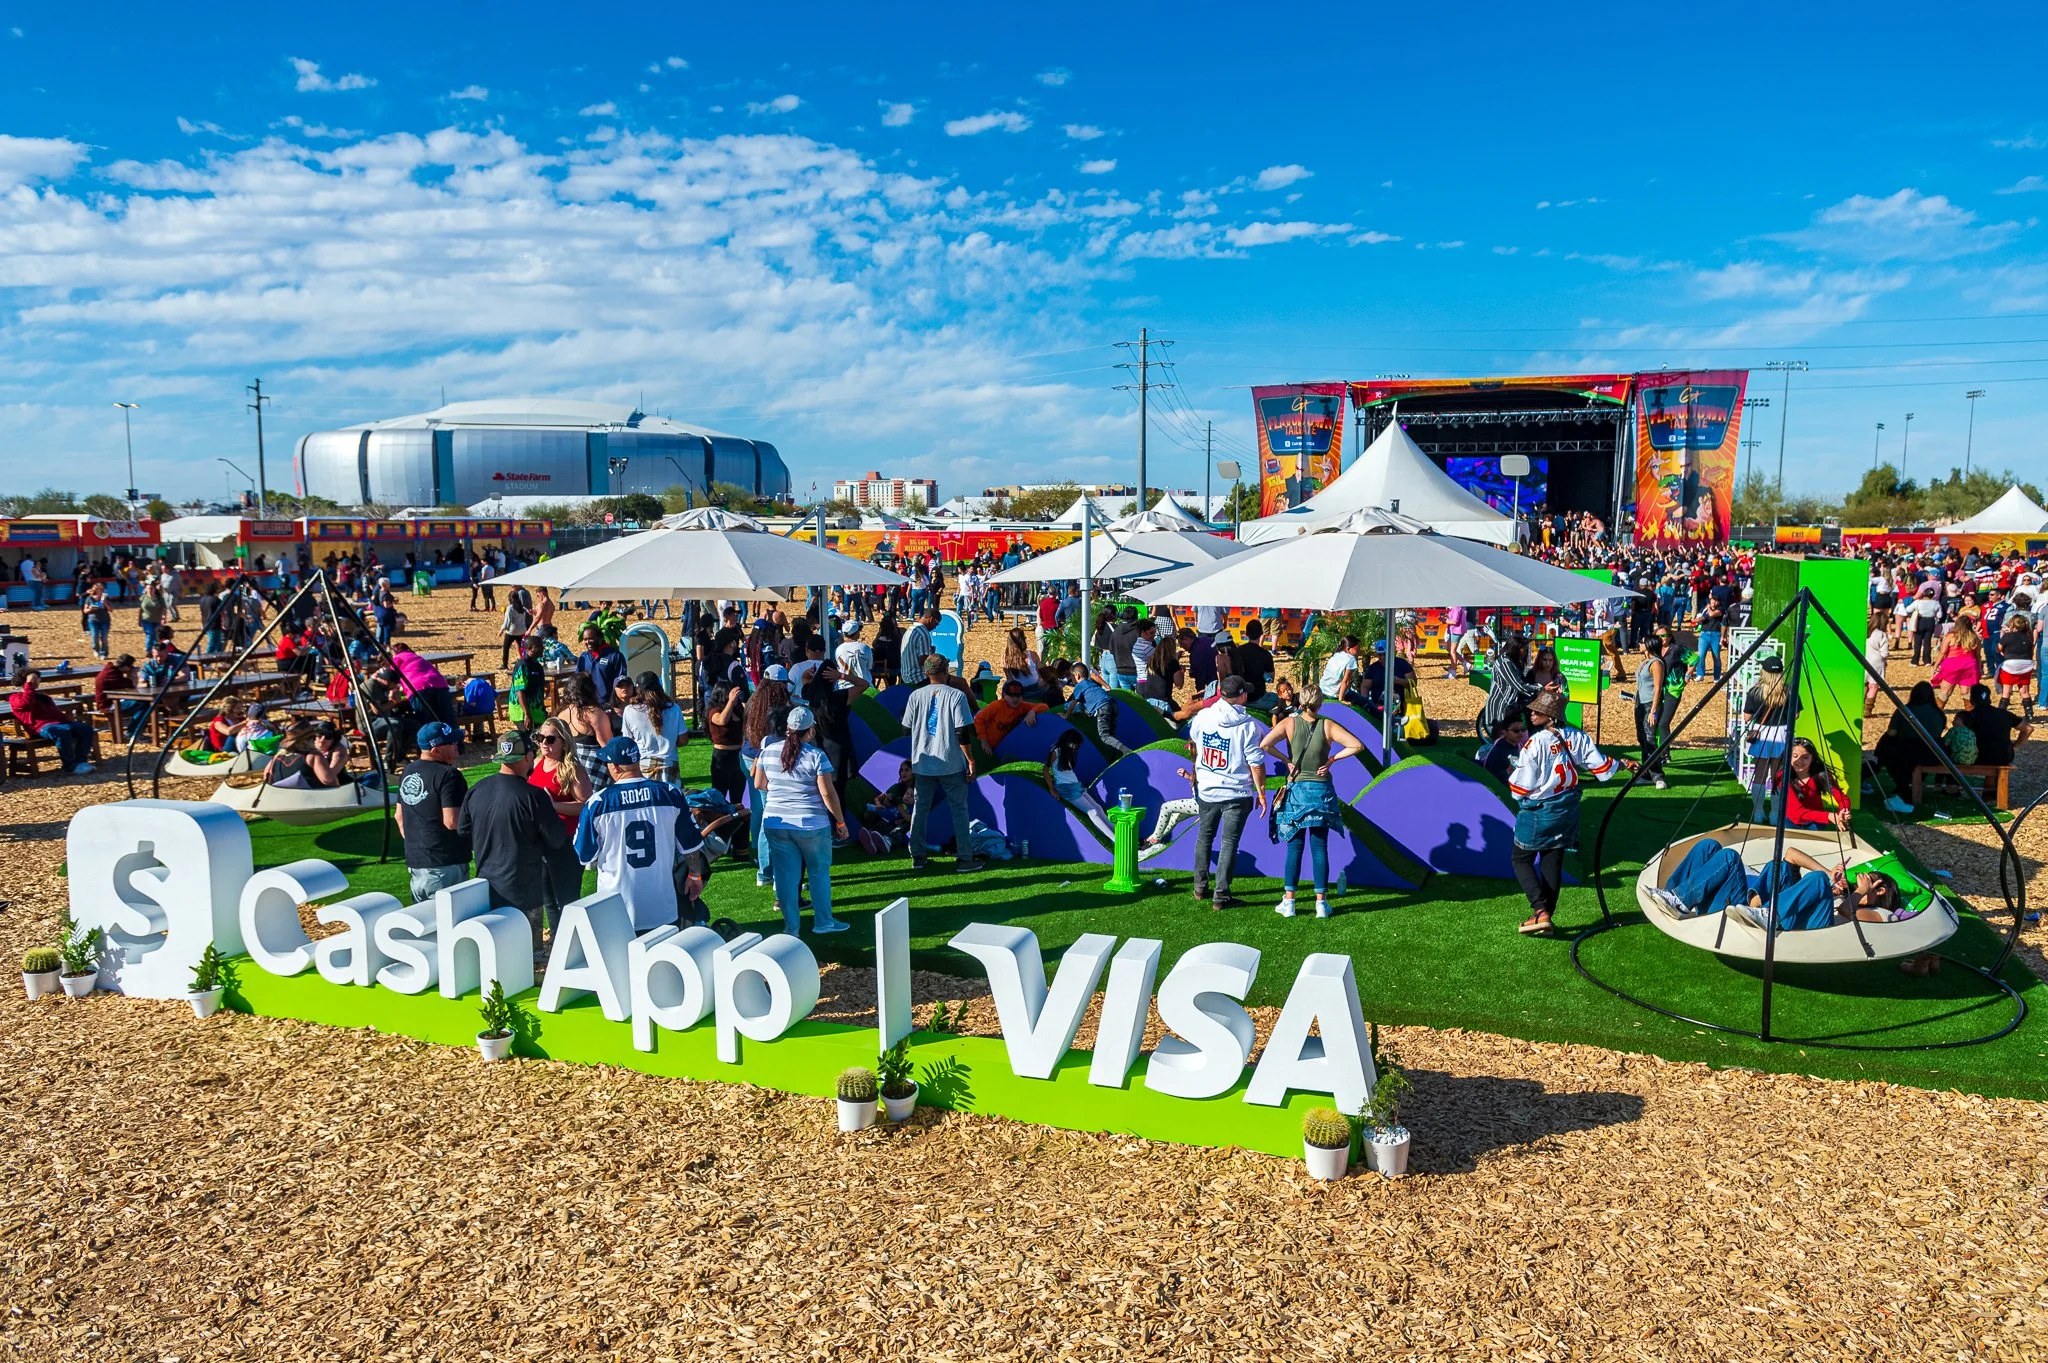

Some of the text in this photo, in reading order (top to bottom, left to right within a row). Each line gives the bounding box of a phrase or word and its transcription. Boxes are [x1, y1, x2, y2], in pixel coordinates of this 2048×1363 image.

[1669, 417, 1709, 430] TAILATE
[1739, 613, 1750, 628] 7
[1983, 608, 1999, 620] 12
[1550, 740, 1573, 755] SMH
[1203, 746, 1227, 768] NFL
[1553, 760, 1578, 794] 11
[620, 787, 651, 805] ROMO
[625, 820, 657, 869] 9
[239, 858, 534, 1003] Cash
[537, 891, 821, 1064] App
[947, 922, 1378, 1117] VISA
